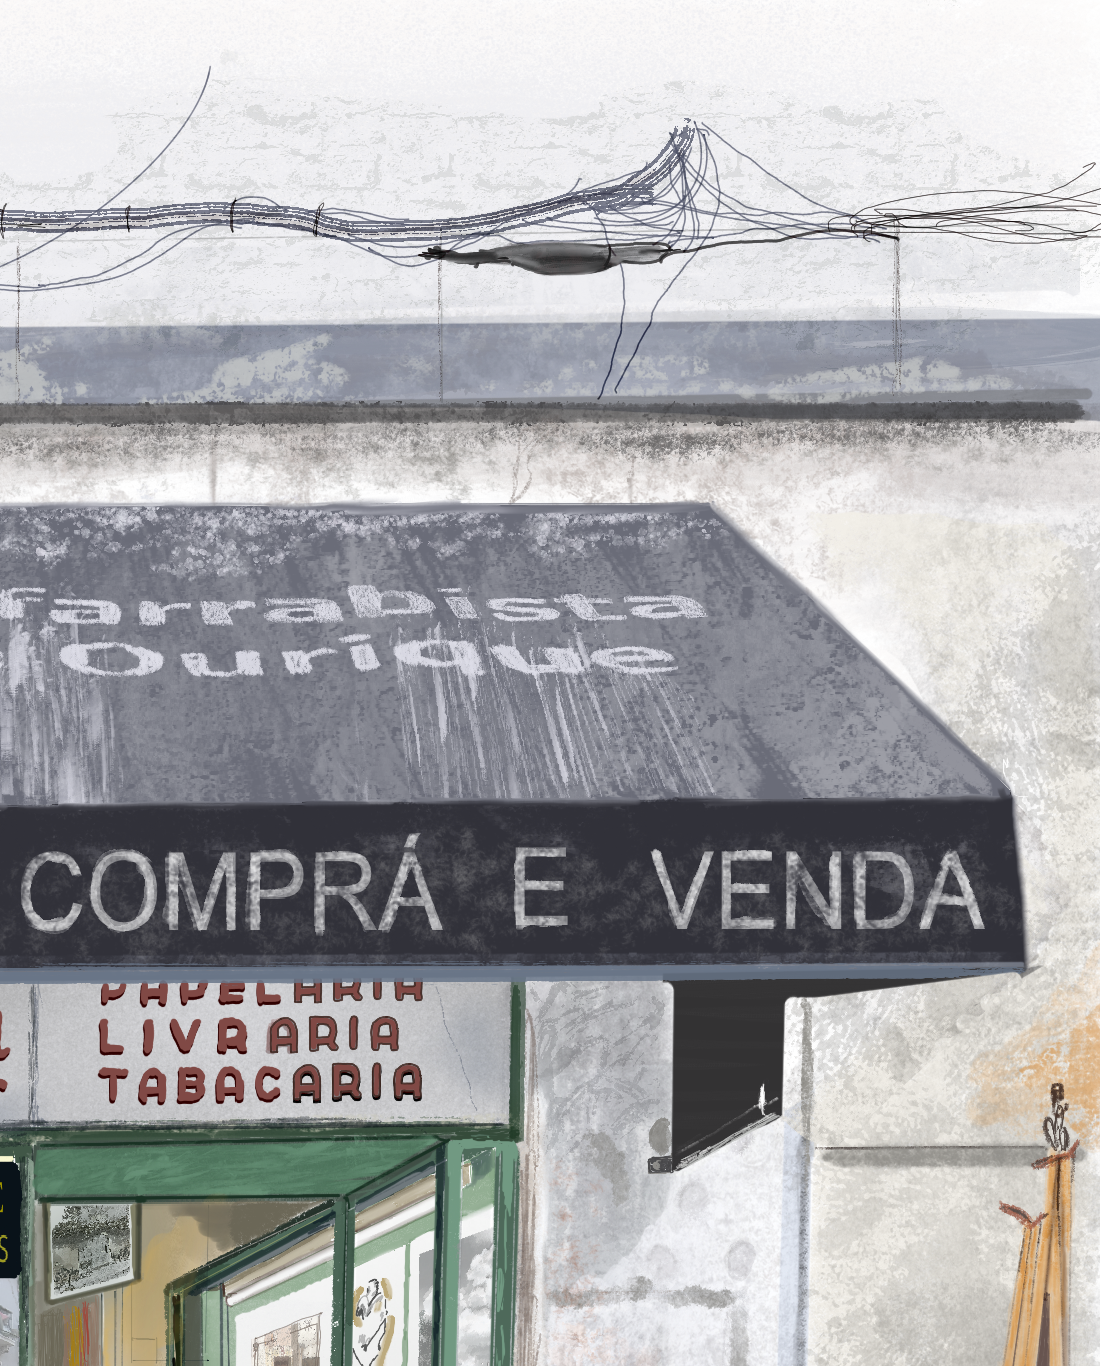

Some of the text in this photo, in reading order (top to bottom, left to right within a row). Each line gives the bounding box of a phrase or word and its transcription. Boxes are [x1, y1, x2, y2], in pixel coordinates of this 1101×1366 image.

[59, 634, 679, 677] Ourique
[20, 832, 443, 935] COMPRÁ
[512, 845, 569, 929] E
[649, 847, 986, 933] VENDA
[99, 1016, 400, 1056] LIVRARIA
[98, 1062, 423, 1105] TABACARIA
